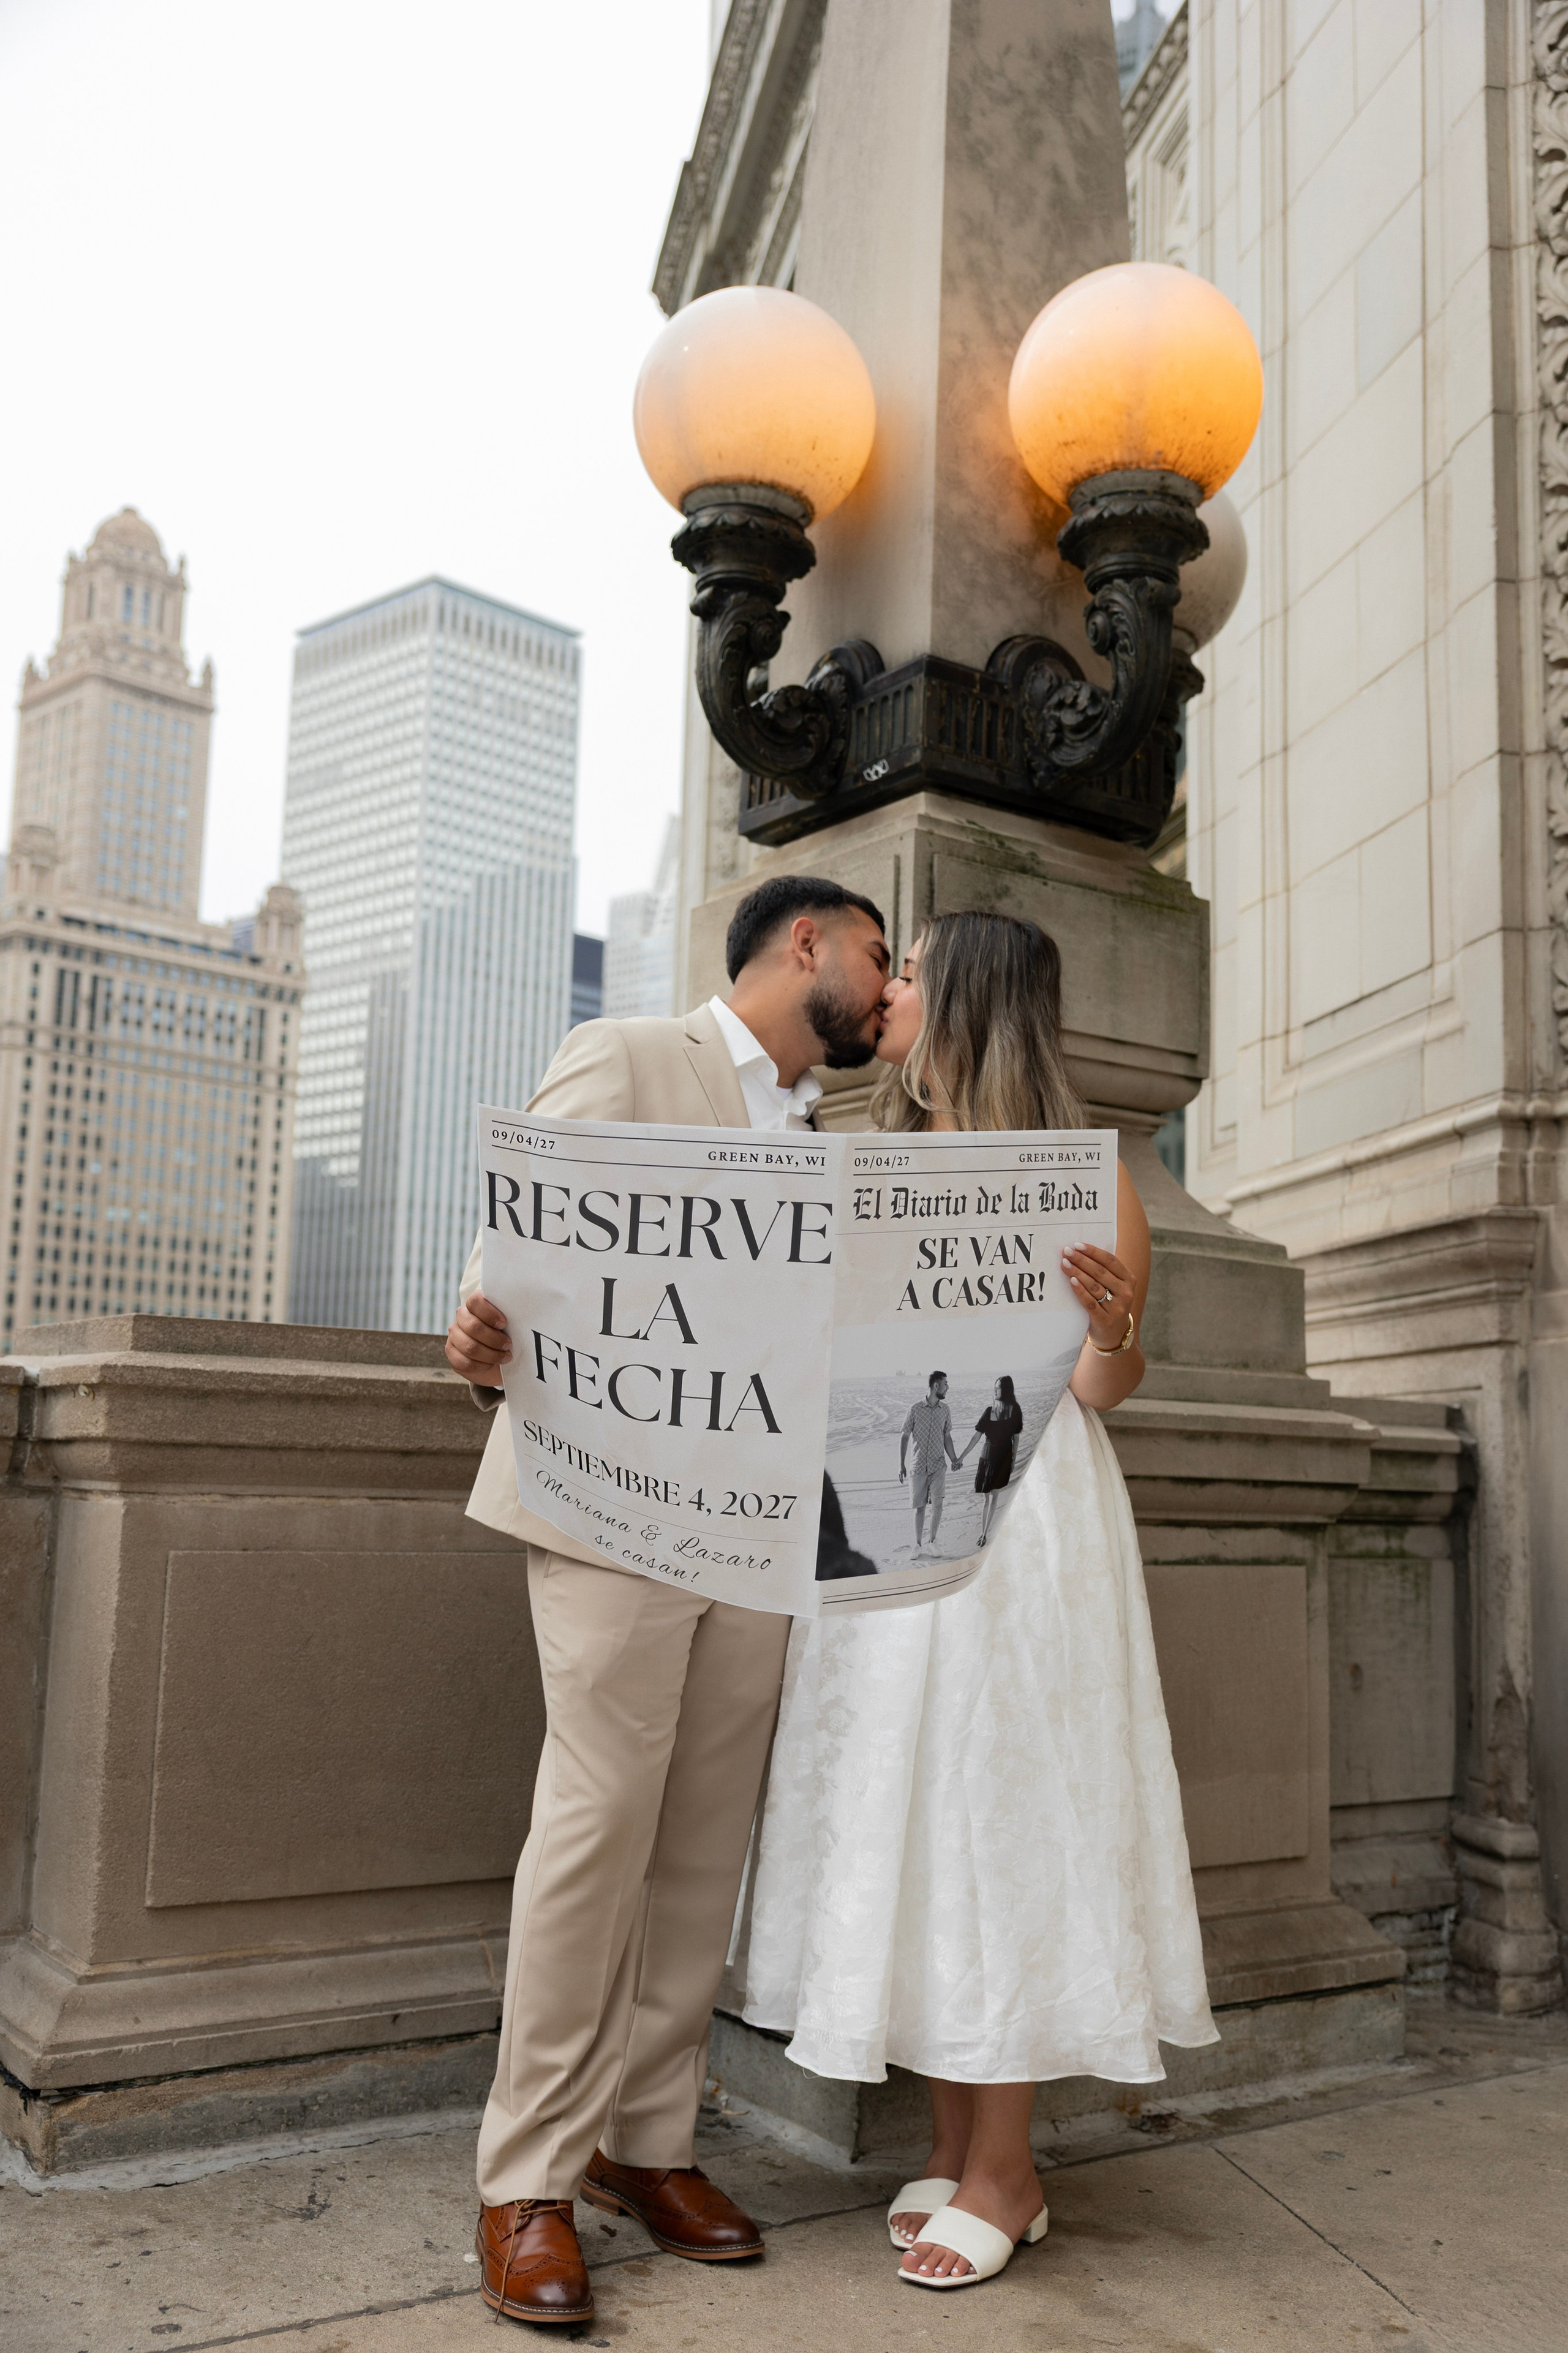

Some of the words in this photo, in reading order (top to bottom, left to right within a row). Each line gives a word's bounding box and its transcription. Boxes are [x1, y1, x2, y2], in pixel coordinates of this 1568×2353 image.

[492, 1128, 556, 1150] 09/04/27
[707, 1150, 760, 1163] GREEN
[764, 1154, 800, 1167] BAY,
[805, 1156, 826, 1166] WI
[1019, 1152, 1054, 1163] GREEN
[1058, 1152, 1082, 1164] BAY,
[1085, 1152, 1101, 1161] WI
[854, 1154, 910, 1168] 09/04/27
[485, 1170, 833, 1264] RESERVE
[853, 1187, 882, 1221] El
[890, 1187, 968, 1220] Diario
[976, 1186, 1003, 1215] de
[1010, 1183, 1030, 1214] la
[1038, 1181, 1098, 1213] Boda
[917, 1237, 959, 1270] SE
[968, 1234, 1034, 1267] VAN
[598, 1277, 698, 1345] LA
[896, 1279, 921, 1312] A
[932, 1271, 1046, 1309] CASAR!
[531, 1329, 782, 1433] FECHA
[523, 1419, 680, 1506] SEPTIEMBRE
[688, 1487, 712, 1516] 4,
[720, 1491, 797, 1520] 2027
[537, 1470, 631, 1533] Mariana
[641, 1524, 662, 1546] &
[673, 1536, 773, 1571] Lazaro
[595, 1535, 614, 1550] se
[622, 1548, 700, 1584] casan!
